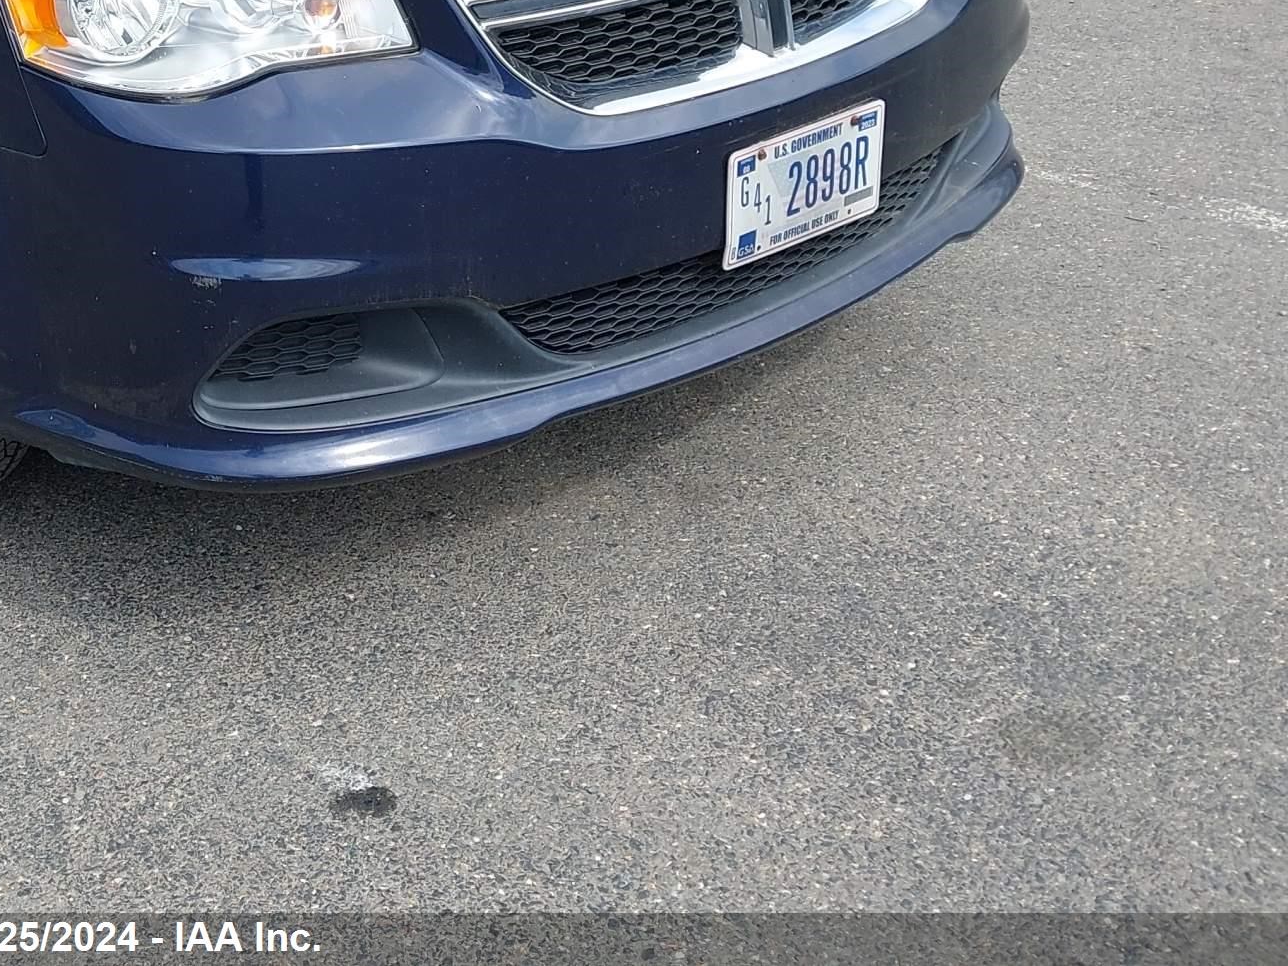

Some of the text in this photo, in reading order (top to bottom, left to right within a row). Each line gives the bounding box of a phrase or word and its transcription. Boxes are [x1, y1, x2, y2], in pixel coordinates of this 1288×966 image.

[774, 123, 843, 159] U.S. GOVERNMENT
[786, 135, 869, 217] 2898R
[769, 210, 839, 246] FOR OFFICIAL USE ONLY
[738, 244, 755, 256] GSA
